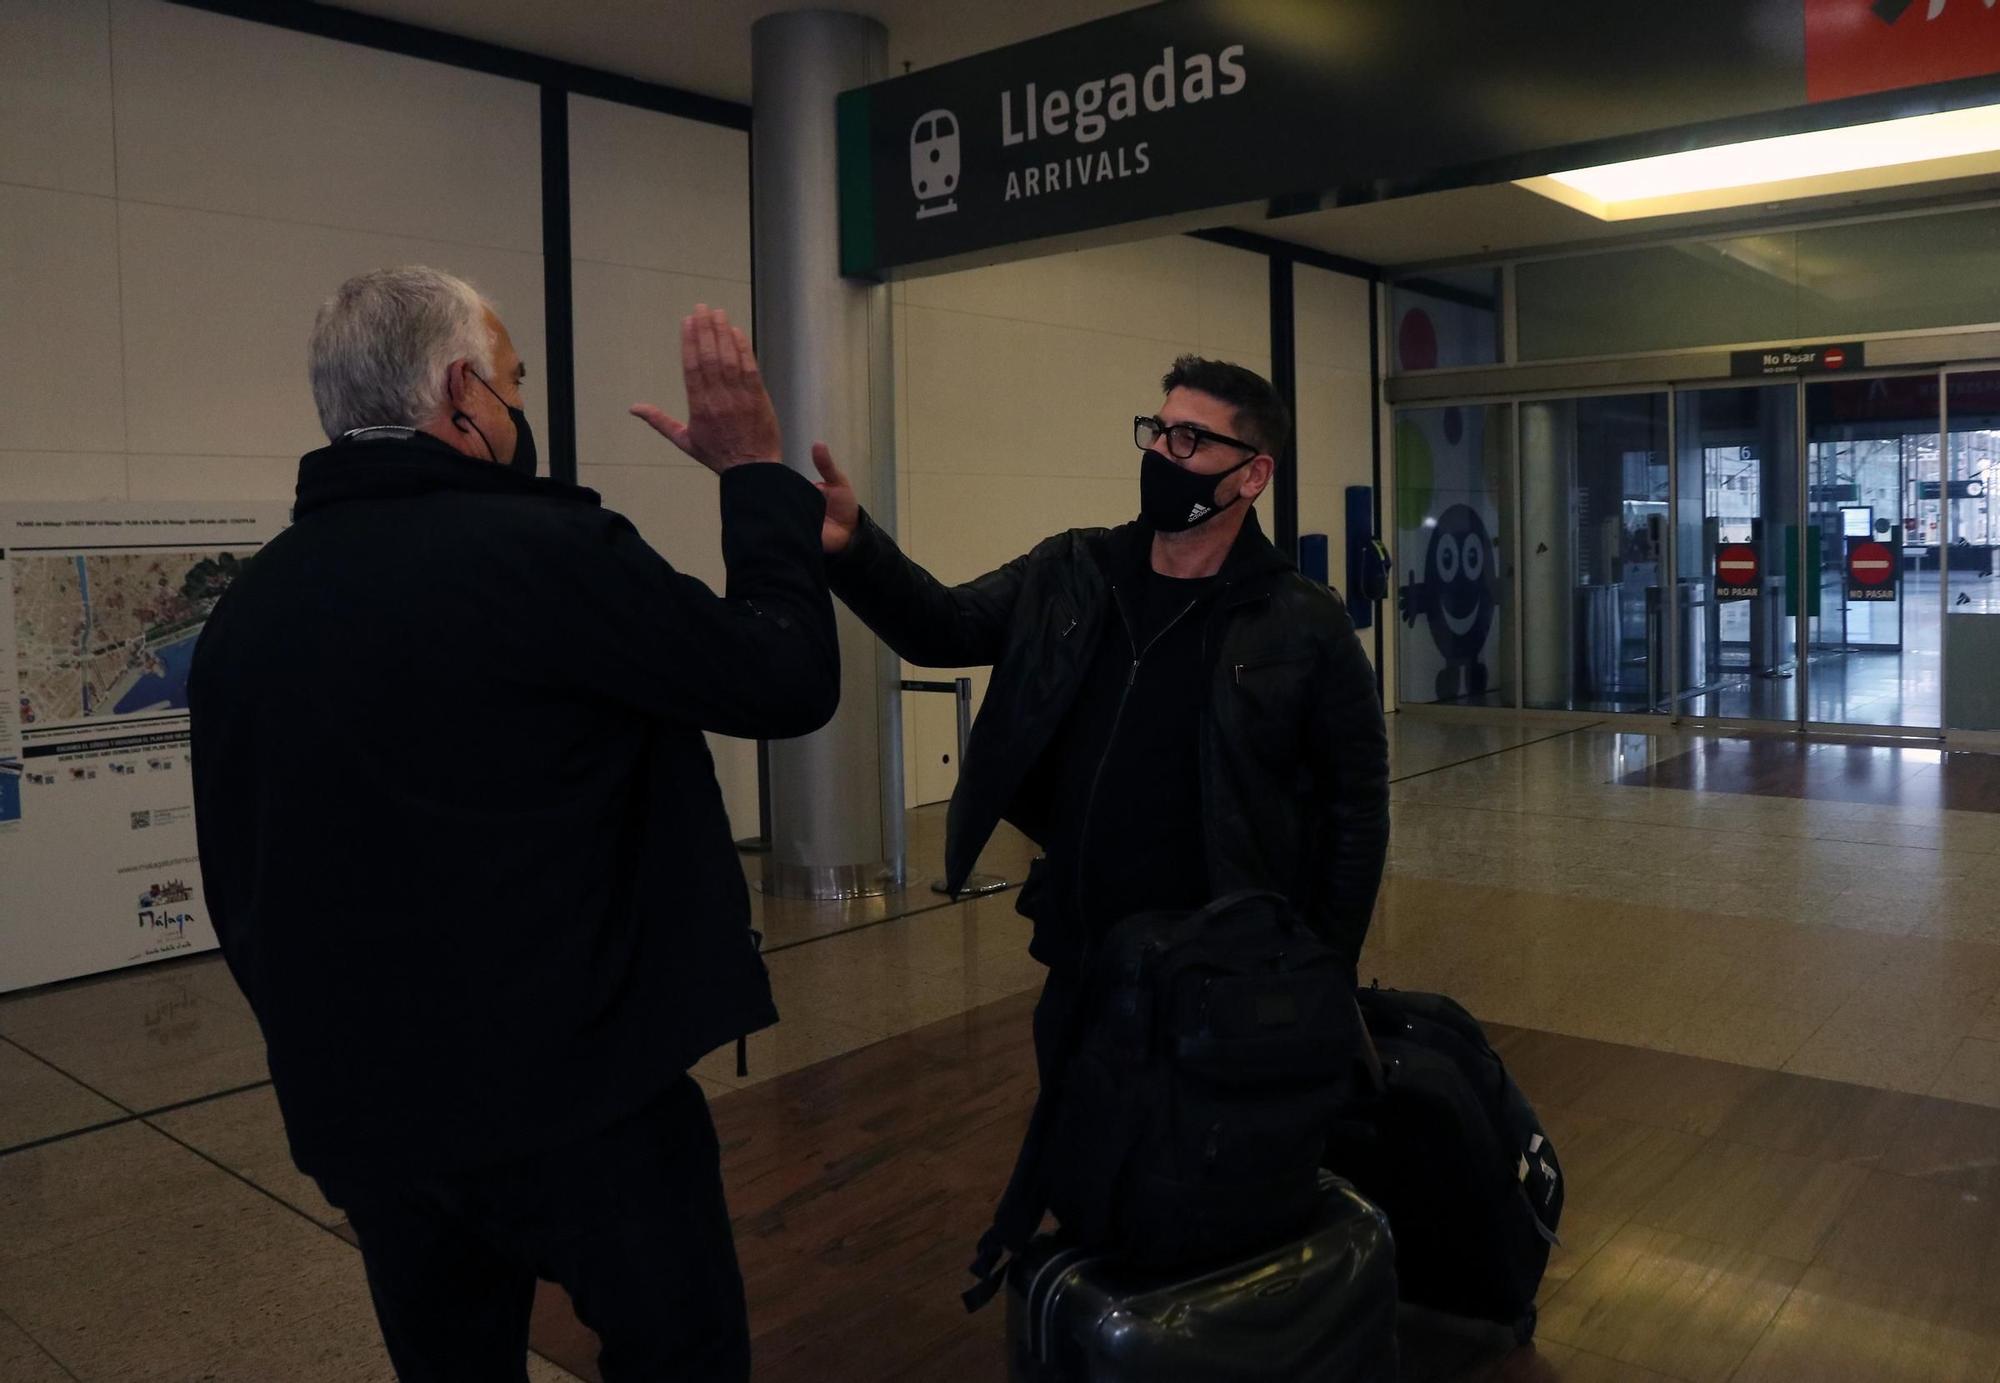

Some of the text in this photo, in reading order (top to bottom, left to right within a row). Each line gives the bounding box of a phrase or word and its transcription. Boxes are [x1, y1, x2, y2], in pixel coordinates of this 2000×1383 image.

[1001, 45, 1247, 147] Llegadas
[1004, 142, 1150, 201] ARRIVALS
[1763, 353, 1816, 366] No Pasar
[1741, 445, 1751, 460] 6
[1716, 587, 1759, 597] NO PASAR
[1849, 589, 1895, 599] NO PASAR
